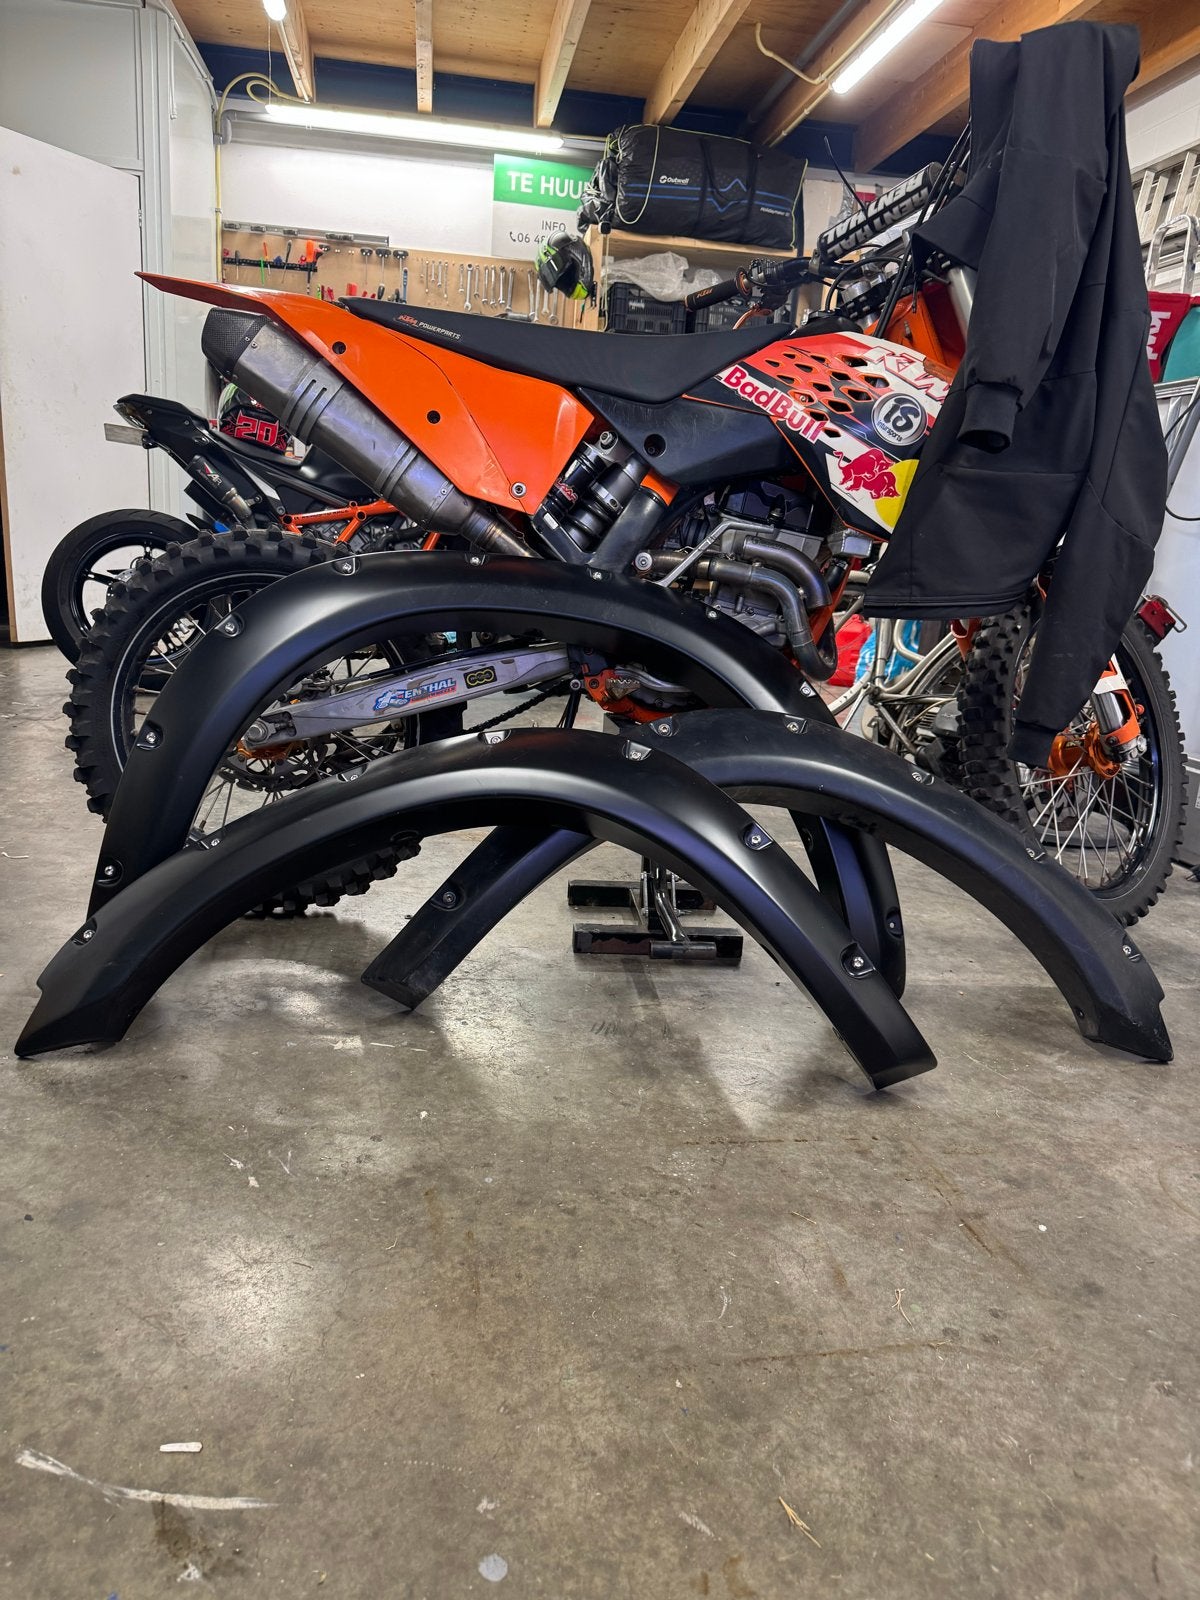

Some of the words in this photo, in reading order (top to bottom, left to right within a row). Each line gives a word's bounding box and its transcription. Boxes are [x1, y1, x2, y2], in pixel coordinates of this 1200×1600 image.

[507, 170, 534, 193] TE
[666, 176, 690, 185] Outwell
[541, 220, 567, 232] INFO
[517, 232, 531, 244] 06
[418, 321, 461, 340] POWERPARTS
[722, 365, 825, 443] BadBull
[234, 409, 279, 447] 20
